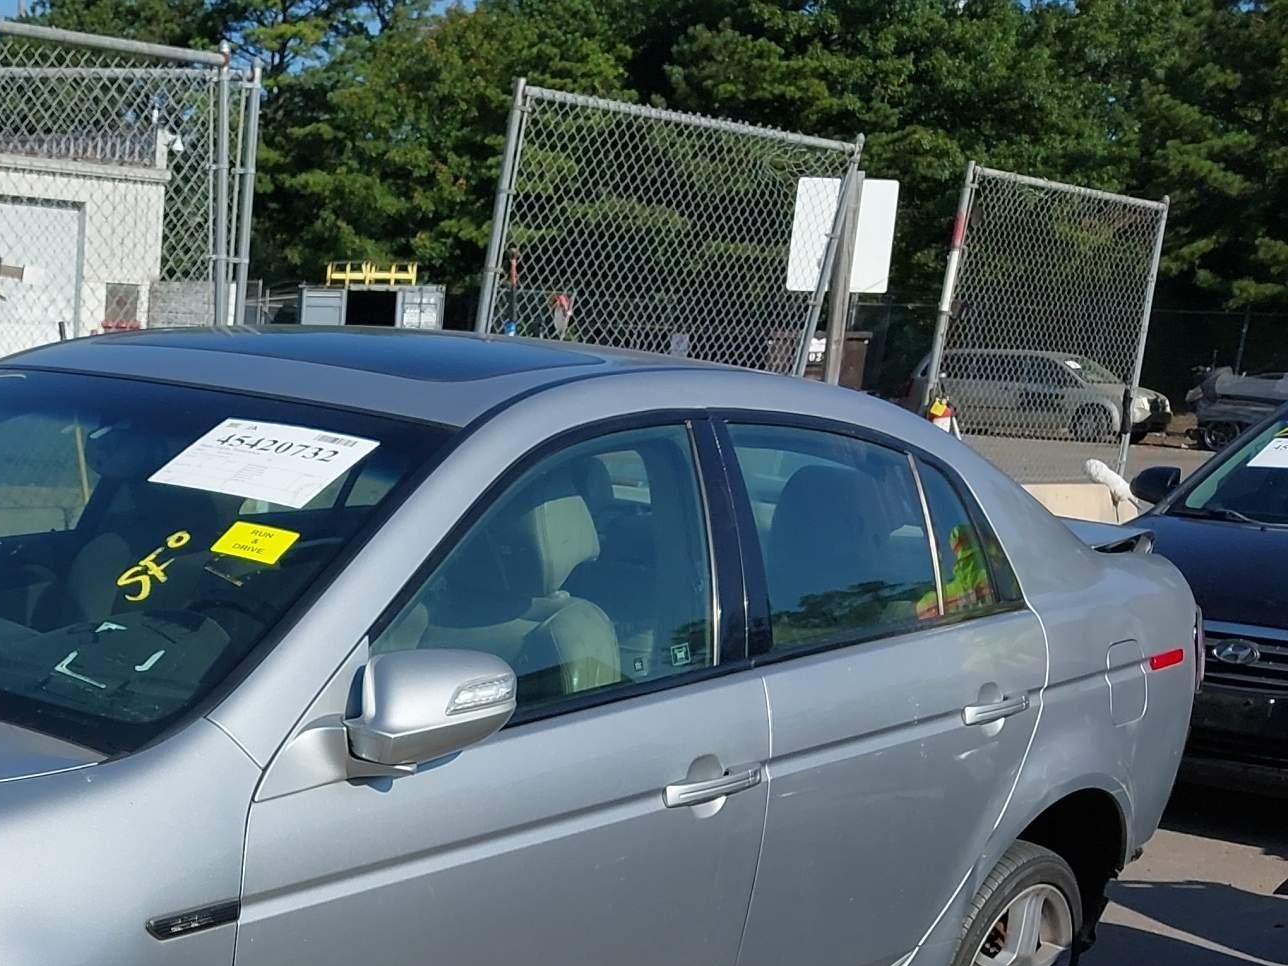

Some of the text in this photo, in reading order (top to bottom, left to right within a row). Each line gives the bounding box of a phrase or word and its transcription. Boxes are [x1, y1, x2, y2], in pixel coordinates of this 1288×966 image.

[216, 433, 339, 463] 45420732
[250, 529, 275, 539] RUN
[232, 543, 265, 555] DRIVE
